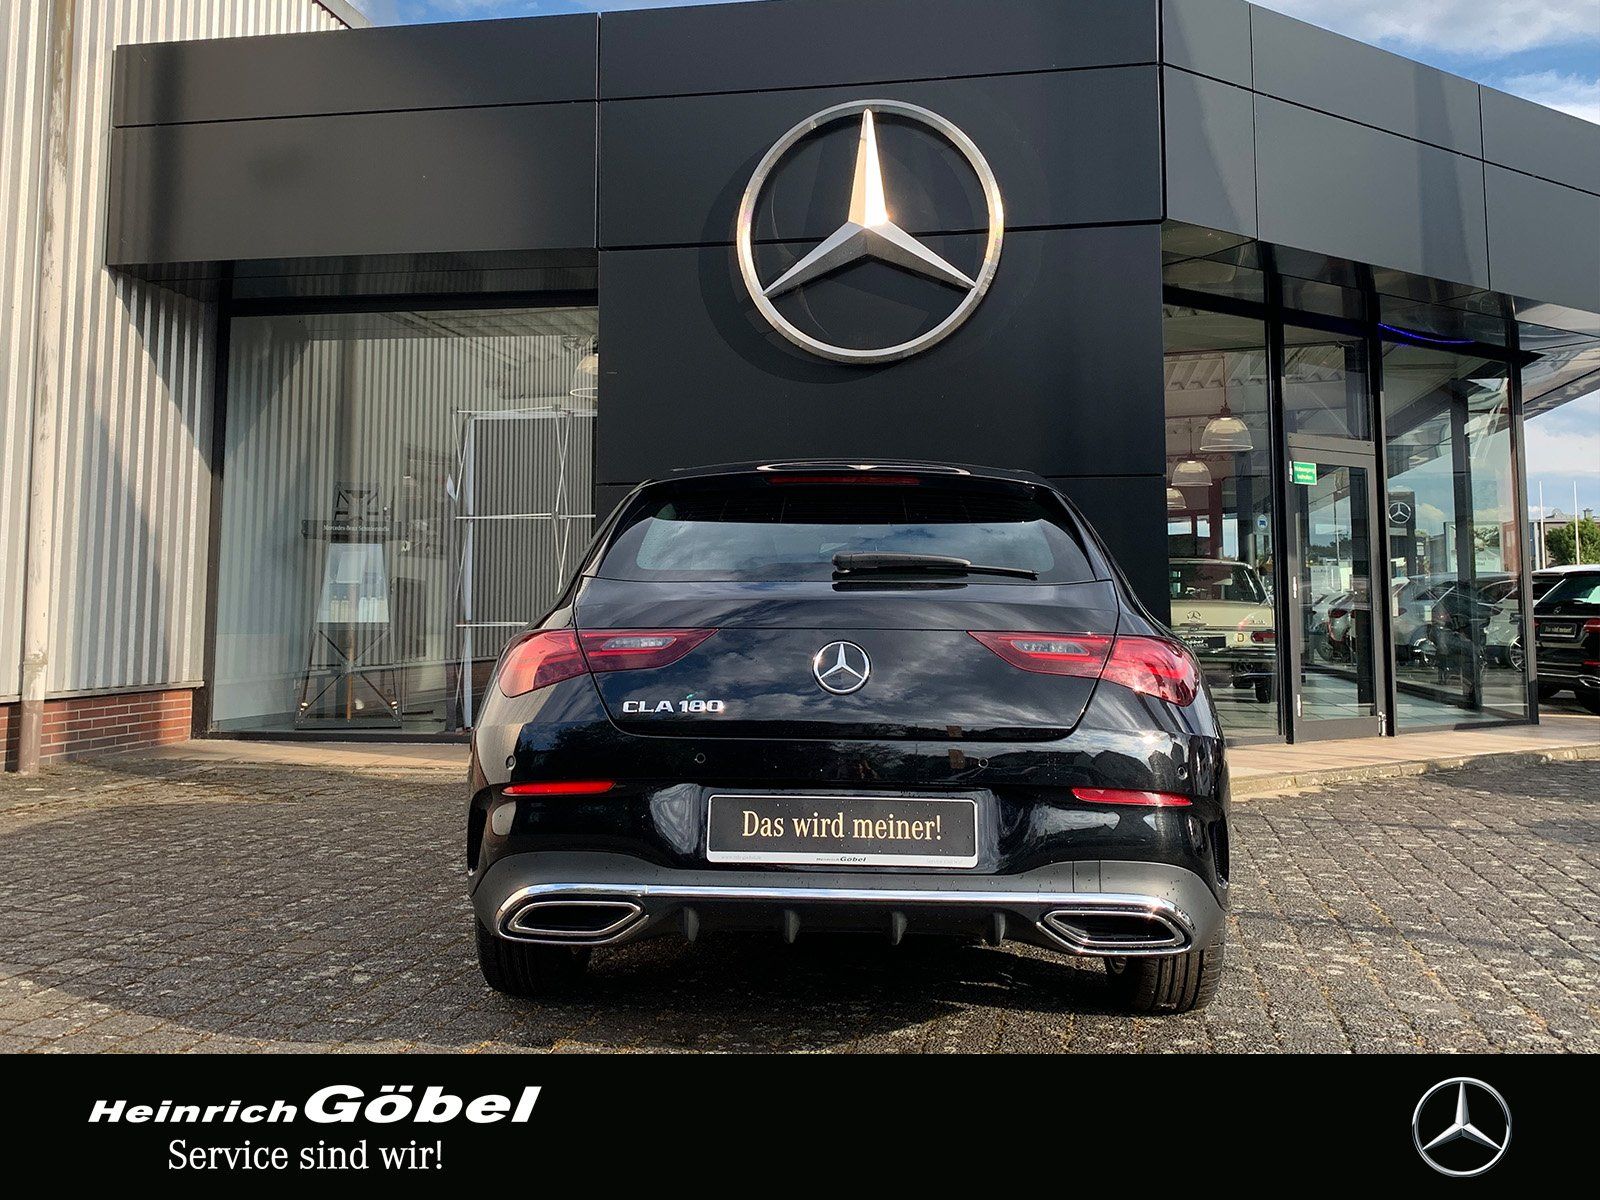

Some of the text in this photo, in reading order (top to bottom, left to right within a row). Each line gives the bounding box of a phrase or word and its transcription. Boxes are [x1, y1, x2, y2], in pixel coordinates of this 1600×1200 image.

[1237, 632, 1245, 643] D
[622, 700, 725, 713] CLA 180
[742, 811, 942, 841] Das wird meiner!
